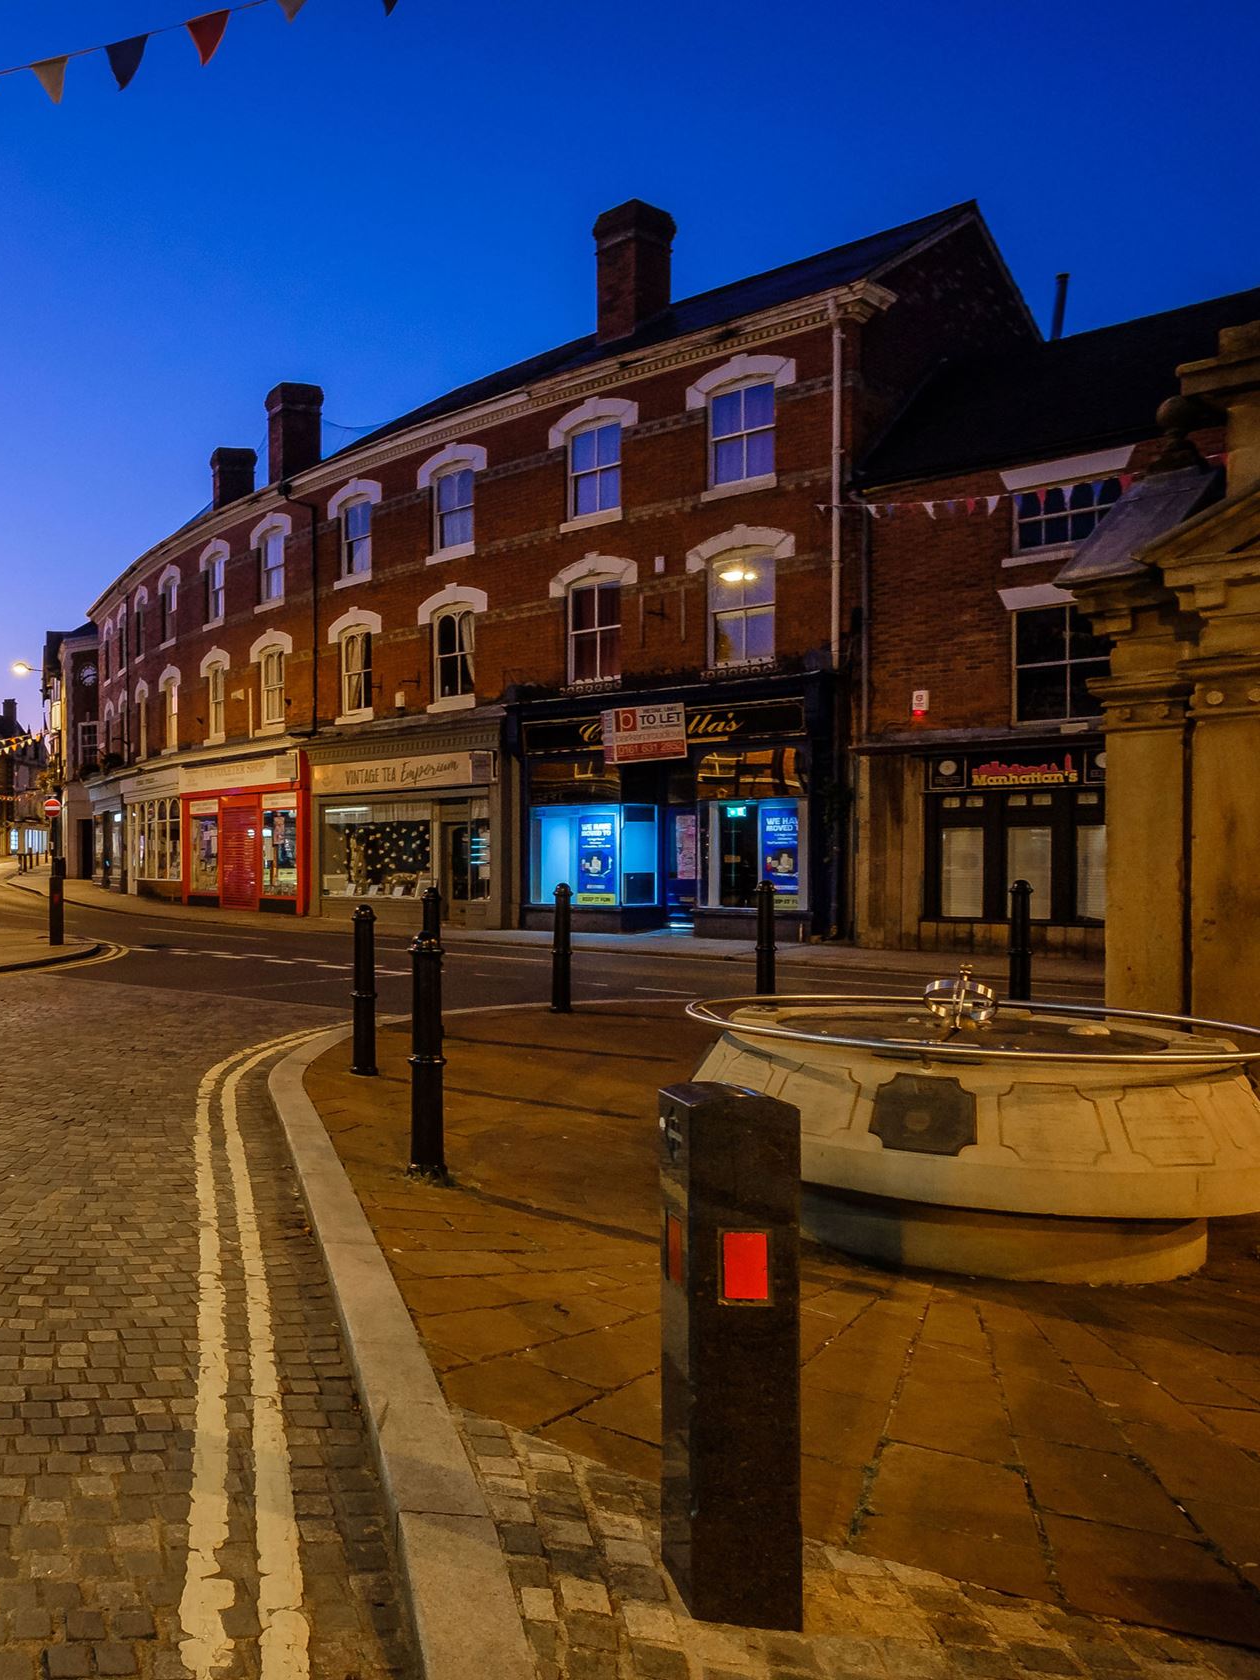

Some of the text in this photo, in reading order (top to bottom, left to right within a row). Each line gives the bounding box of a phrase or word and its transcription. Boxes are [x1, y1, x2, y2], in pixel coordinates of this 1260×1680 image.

[639, 711, 682, 725] TO LET
[618, 744, 638, 755] 0161
[641, 743, 657, 753] 631
[345, 767, 379, 785] VINTAGE
[382, 766, 396, 782] TEA
[400, 760, 458, 785] Emporium
[971, 770, 1078, 786] Manhattan's
[766, 817, 780, 825] WE
